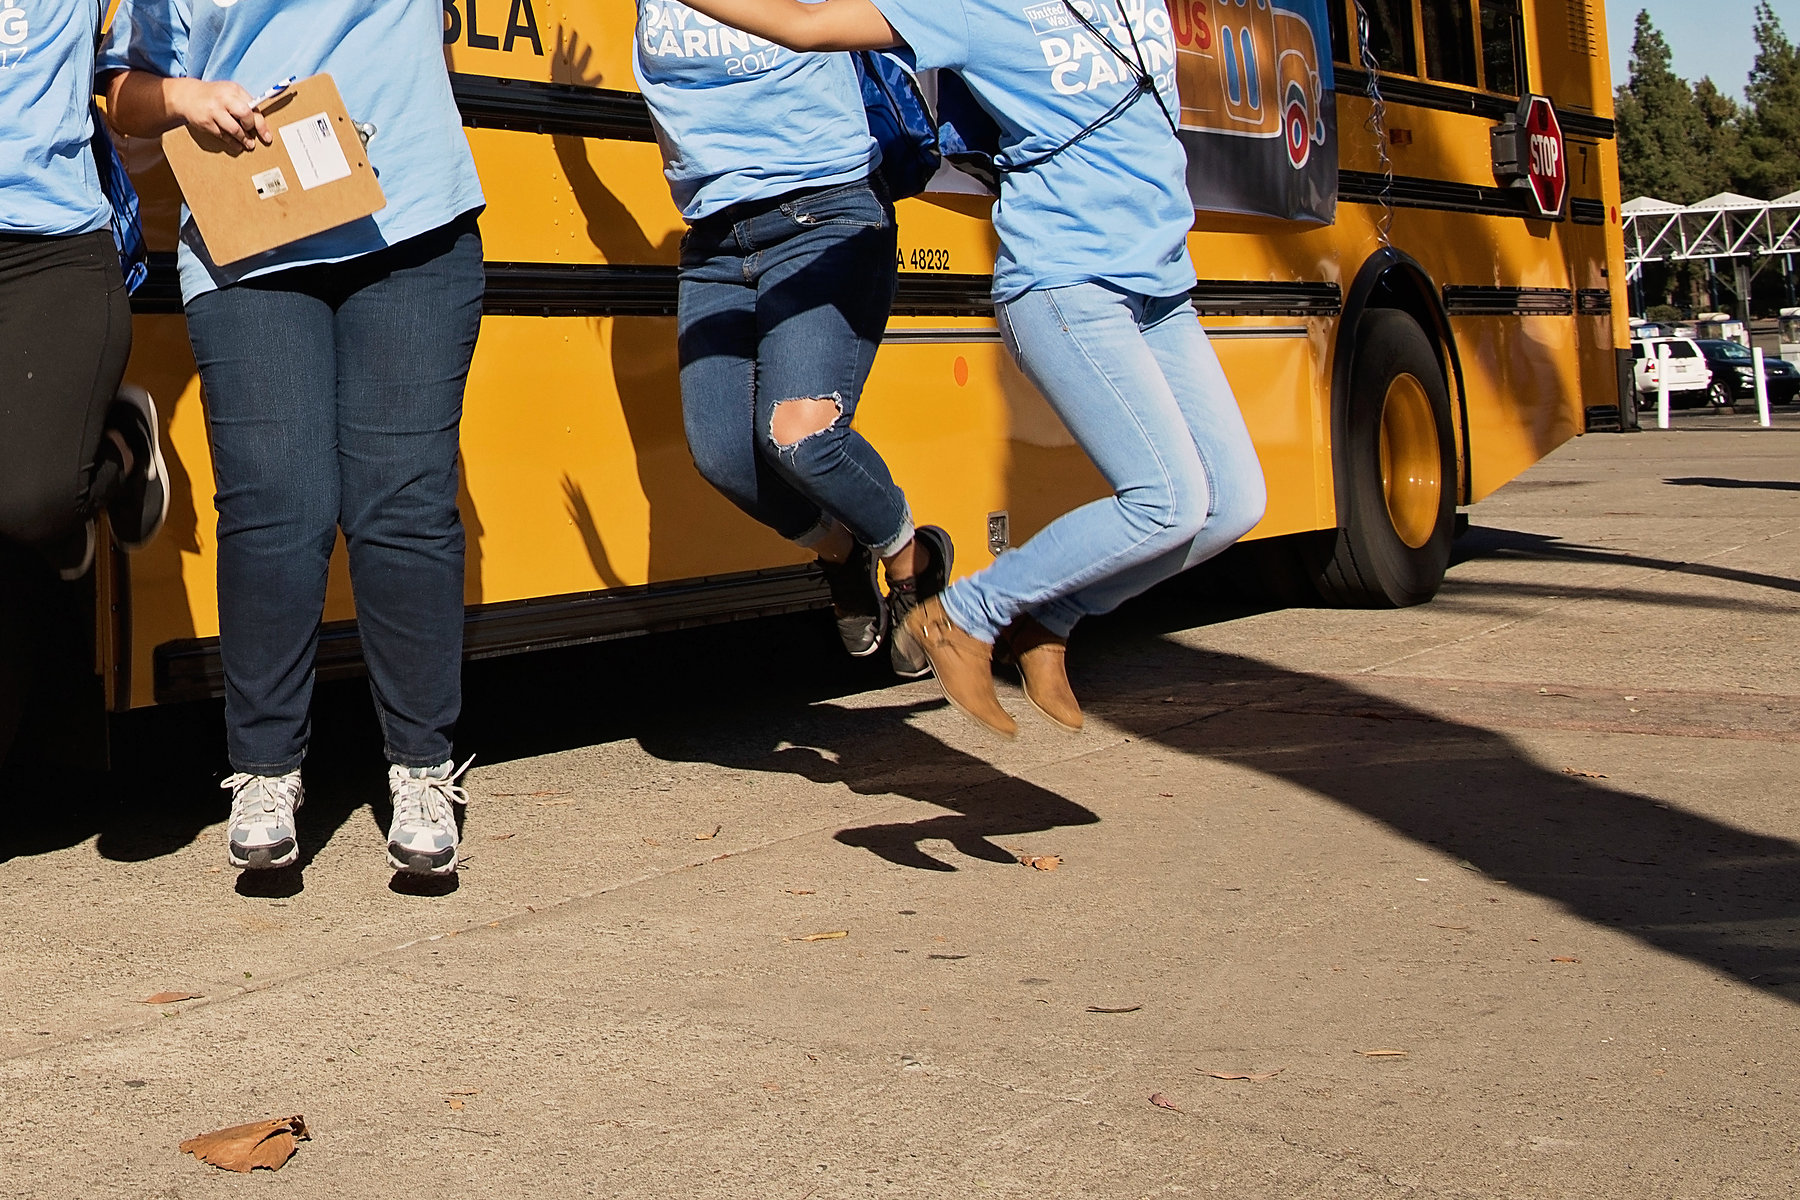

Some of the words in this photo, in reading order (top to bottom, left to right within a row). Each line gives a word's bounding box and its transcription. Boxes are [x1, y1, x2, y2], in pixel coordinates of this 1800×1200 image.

[1027, 3, 1065, 21] United
[1046, 14, 1069, 27] Way
[724, 46, 780, 76] 2017
[1051, 33, 1175, 95] CARIN
[1154, 68, 1176, 97] 20
[1530, 133, 1558, 178] STOP
[910, 248, 950, 271] 48232
